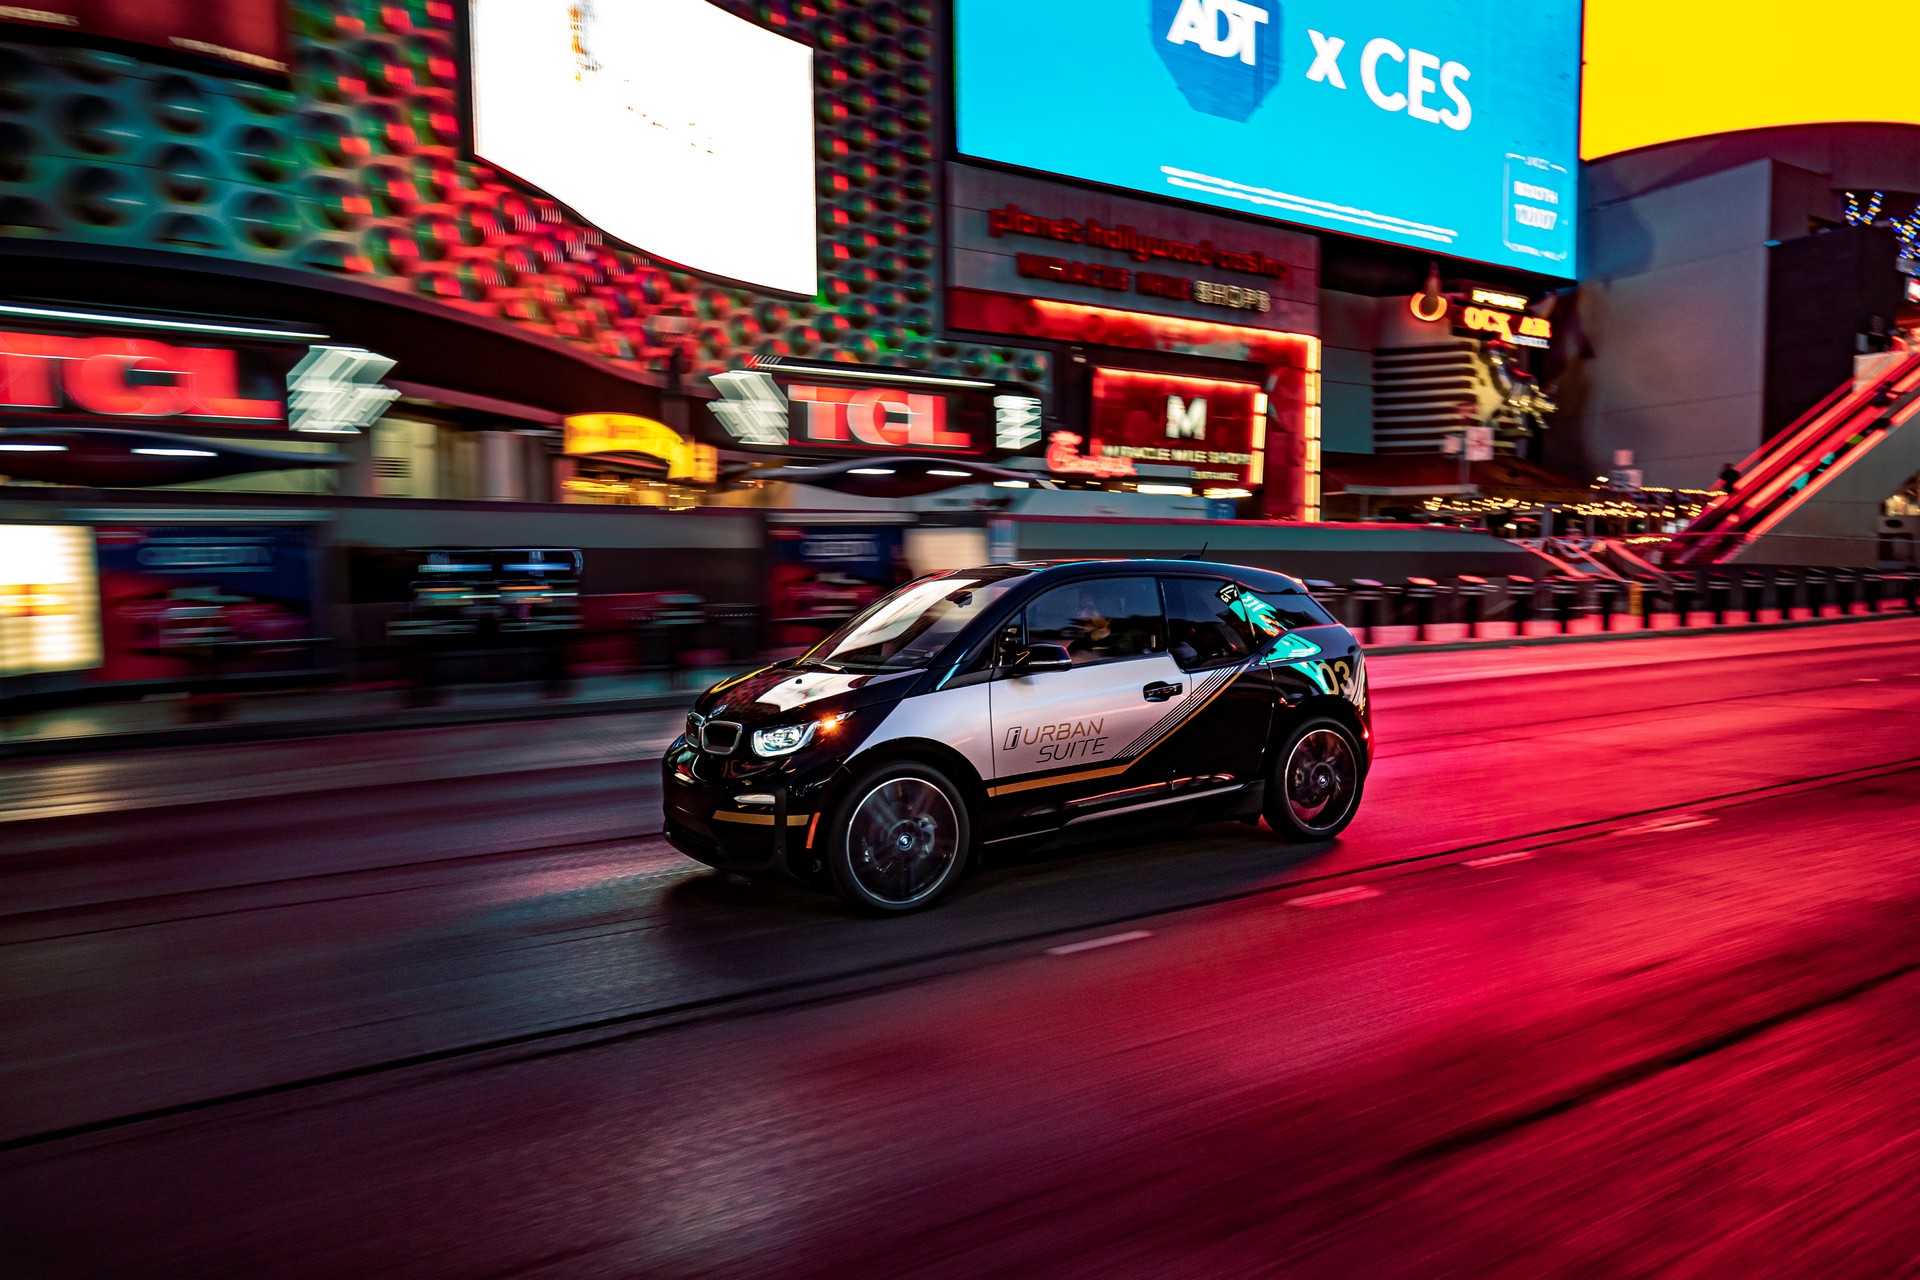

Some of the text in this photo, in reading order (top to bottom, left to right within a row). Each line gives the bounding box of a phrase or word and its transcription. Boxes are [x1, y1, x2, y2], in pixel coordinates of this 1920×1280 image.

[1166, 0, 1268, 65] ADT
[1360, 37, 1472, 131] CES
[1194, 279, 1271, 313] SHOPS
[788, 384, 972, 448] TCL
[1166, 395, 1207, 440] M
[1317, 660, 1355, 696] 03
[1023, 718, 1104, 746] URBAN
[1036, 736, 1109, 764] SUITE
